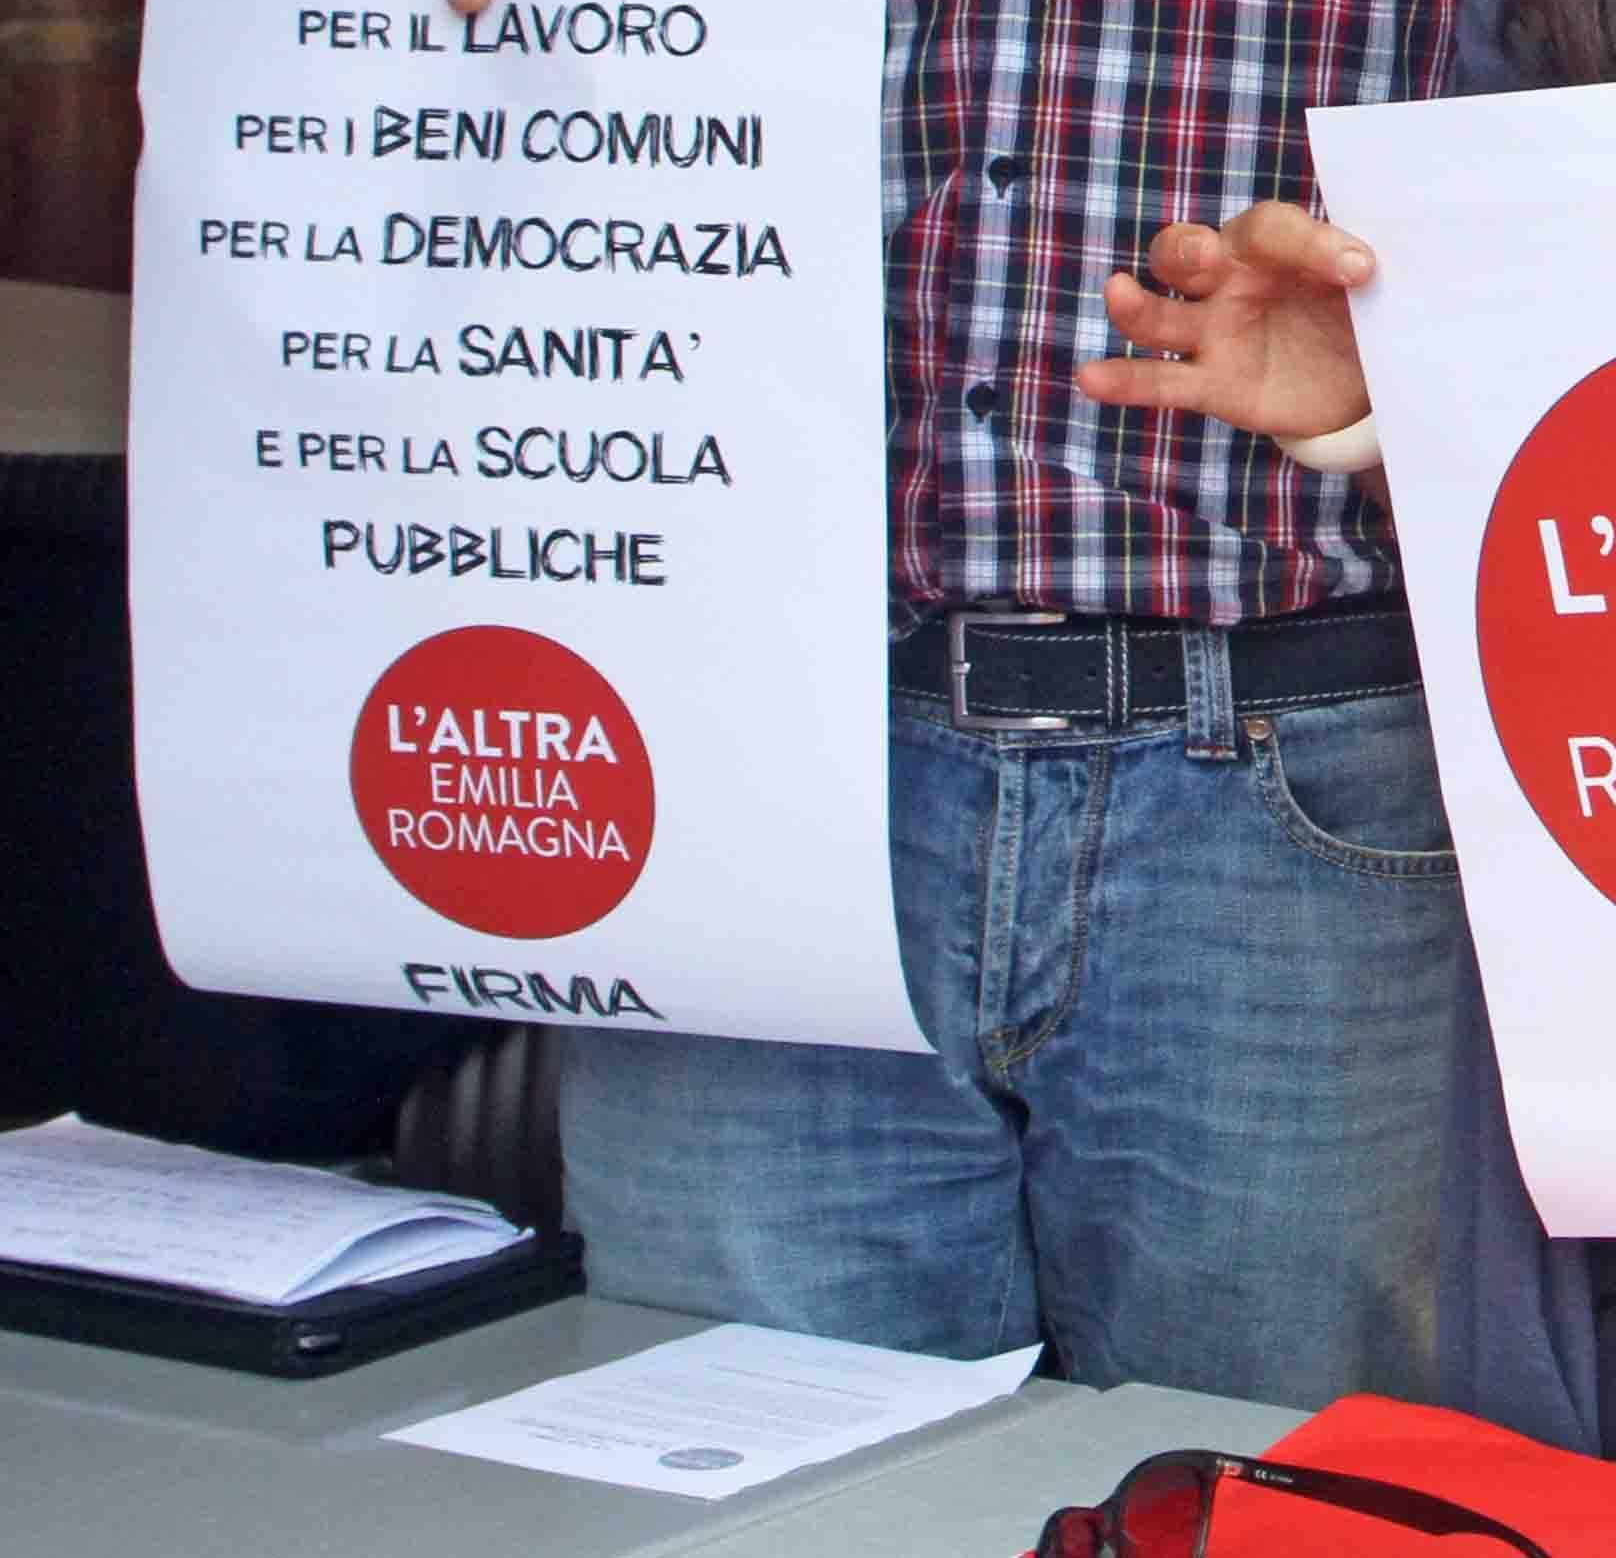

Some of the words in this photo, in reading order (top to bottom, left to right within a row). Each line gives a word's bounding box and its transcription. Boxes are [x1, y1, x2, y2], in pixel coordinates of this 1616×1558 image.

[299, 10, 391, 49] PER
[410, 14, 446, 52] IL
[463, 2, 707, 57] LAVORO
[236, 114, 328, 154] PER
[345, 118, 354, 156] I
[373, 106, 506, 162] BENI
[522, 109, 762, 170] COMUNI
[200, 220, 289, 258] PER
[304, 224, 363, 263] LA
[380, 212, 792, 278] DEMOCRAZIA
[283, 331, 371, 370] PER
[384, 336, 441, 375] LA
[256, 430, 283, 468] E
[298, 432, 386, 471] PER
[403, 437, 459, 476] LA
[477, 426, 732, 487] SCUOLA
[323, 520, 667, 586] PUBBLICHE
[389, 705, 616, 763] L'ALTRA
[431, 763, 578, 810] EMILIA
[389, 809, 629, 860] ROMAGNA
[402, 963, 667, 1020] FIRMA
